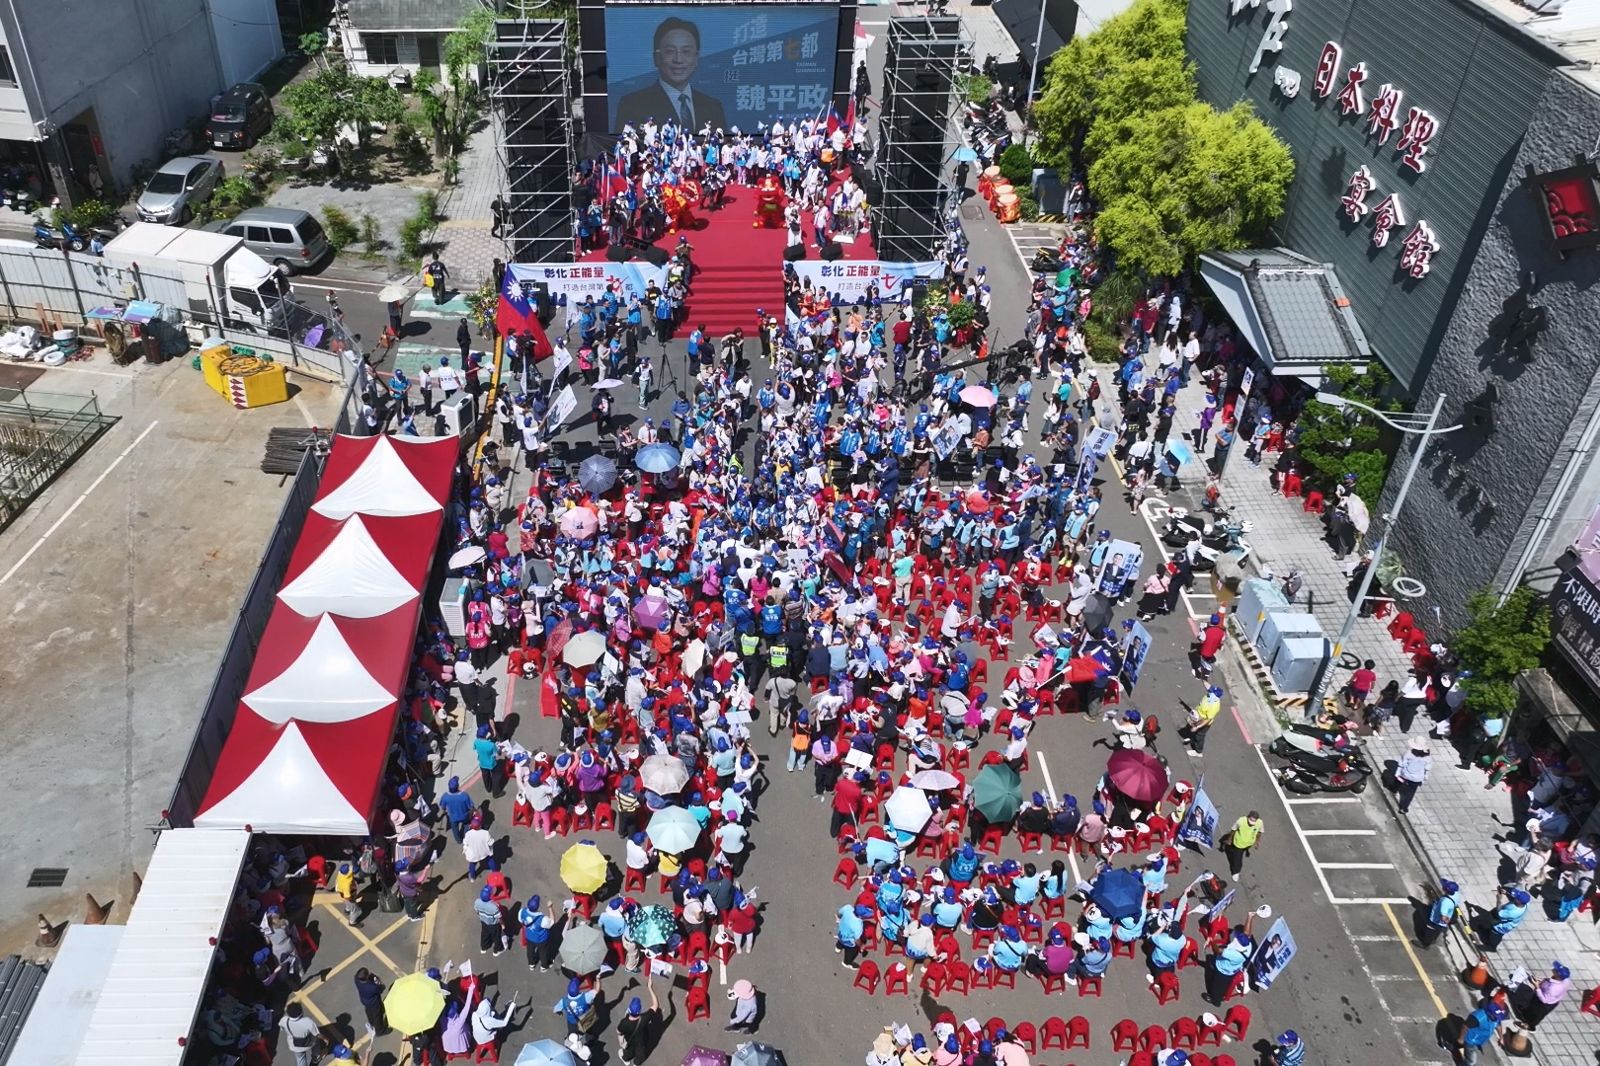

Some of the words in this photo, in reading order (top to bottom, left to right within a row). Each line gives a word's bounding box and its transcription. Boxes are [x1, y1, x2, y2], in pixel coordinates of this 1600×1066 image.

[733, 14, 768, 45] 打造
[732, 31, 819, 67] 台灣第七都
[736, 83, 828, 111] 魏平政
[1315, 40, 1440, 173] 日本料理
[1341, 164, 1441, 279] 宴會館
[544, 267, 567, 279] 彰化
[569, 266, 604, 278] 正能量
[821, 265, 844, 277] 彰化
[846, 265, 880, 277] 正能量
